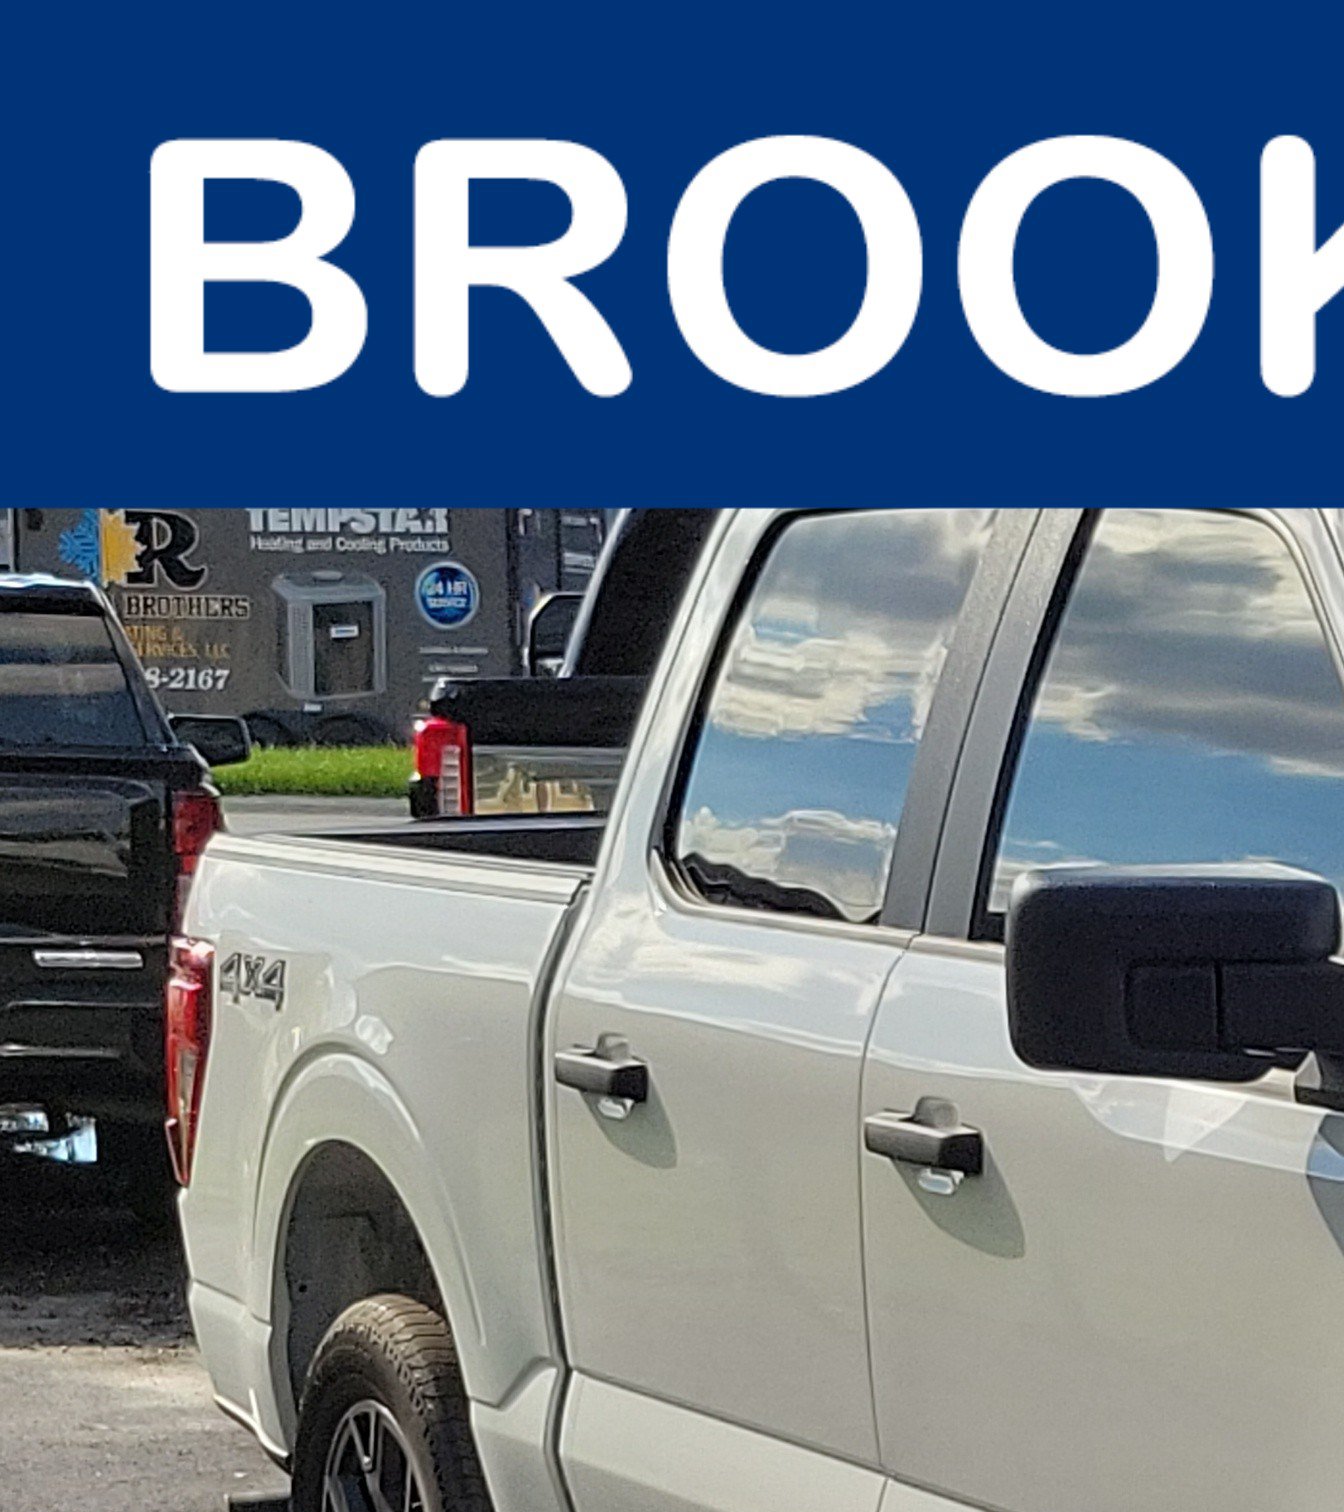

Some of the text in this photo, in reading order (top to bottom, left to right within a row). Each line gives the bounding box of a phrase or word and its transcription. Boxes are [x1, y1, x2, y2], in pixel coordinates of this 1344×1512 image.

[251, 537, 449, 554] Heating and Cooling Products
[125, 594, 250, 619] BROTHERS
[144, 667, 230, 691] 8-2167
